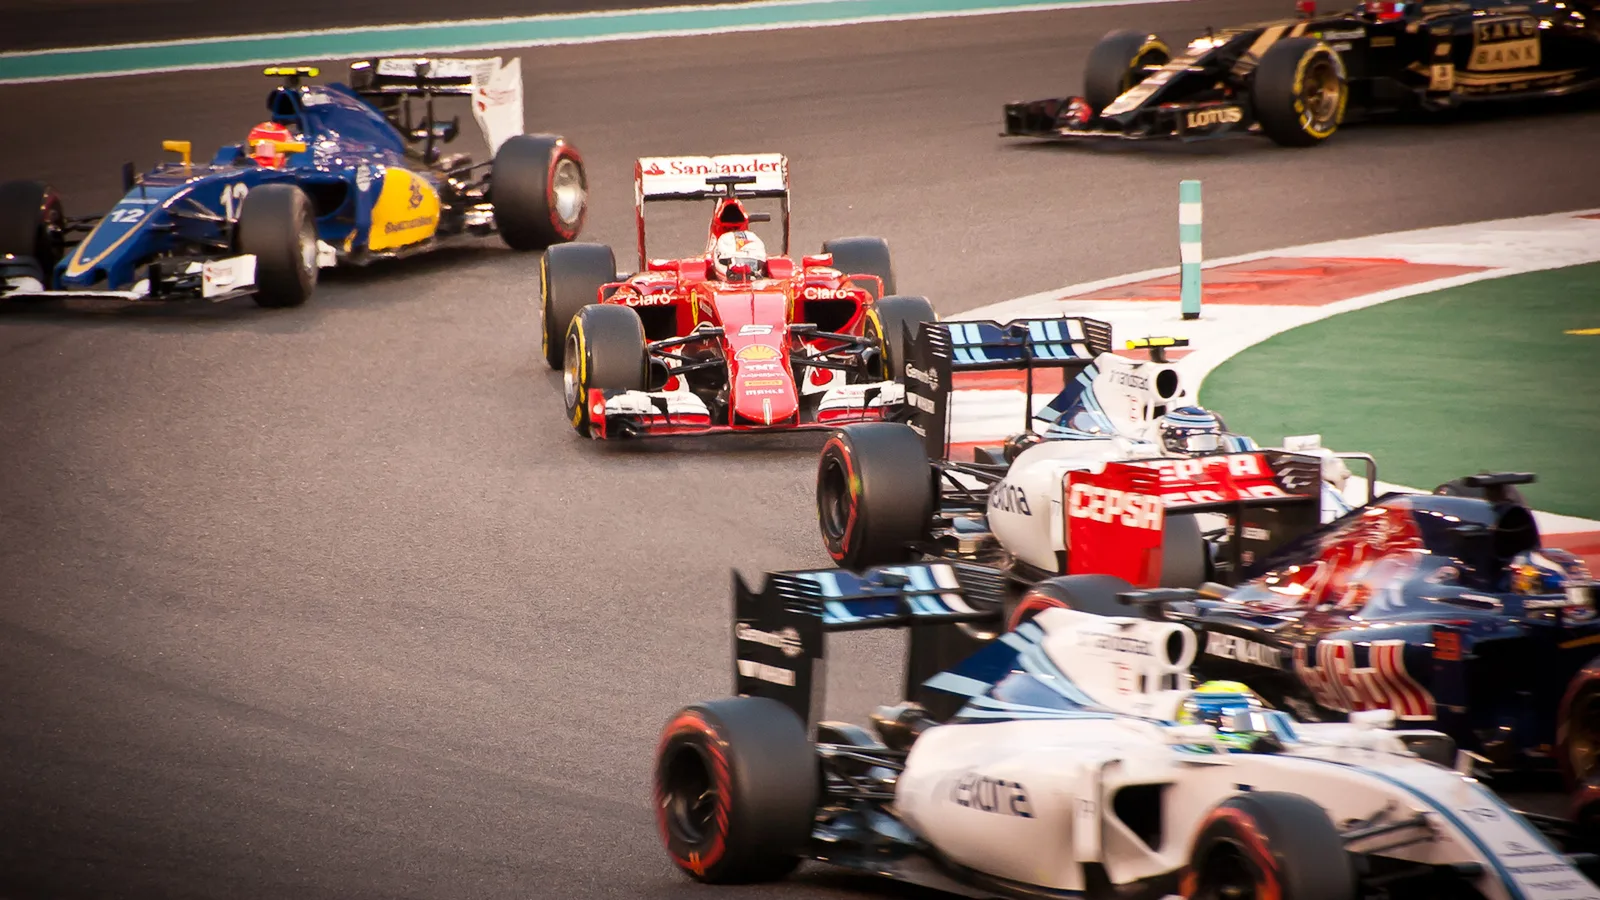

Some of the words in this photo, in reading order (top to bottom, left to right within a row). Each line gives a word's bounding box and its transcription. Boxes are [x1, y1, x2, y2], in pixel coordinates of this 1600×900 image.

[1476, 46, 1536, 65] BANK
[1187, 106, 1242, 128] LOTUS
[670, 158, 781, 175] Santander
[111, 208, 145, 223] 12
[626, 290, 677, 307] Claro
[804, 287, 854, 300] Claro
[738, 324, 774, 337] 5
[1069, 482, 1161, 531] CEPSA
